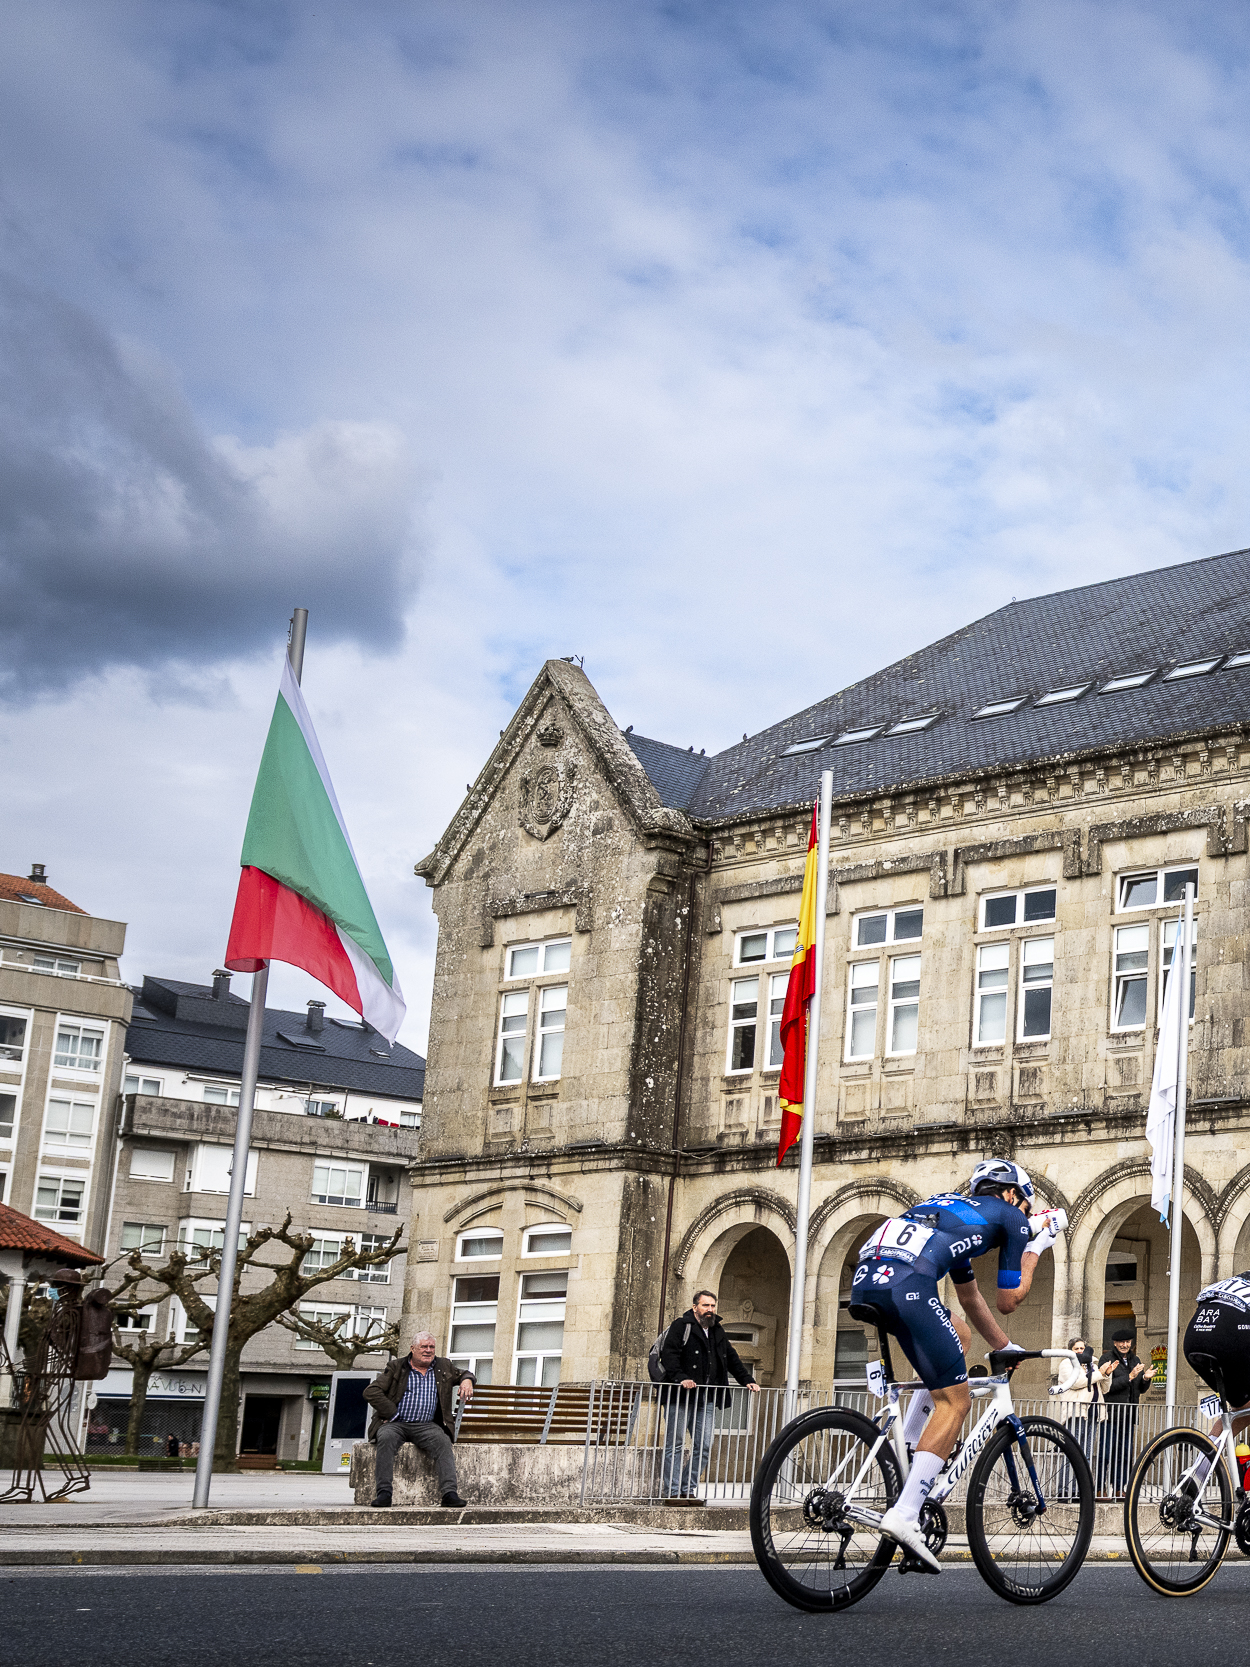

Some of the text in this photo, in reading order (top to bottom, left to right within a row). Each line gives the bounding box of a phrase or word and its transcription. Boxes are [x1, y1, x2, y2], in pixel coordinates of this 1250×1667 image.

[896, 1223, 917, 1246] 6
[949, 1237, 972, 1258] FDJ
[927, 1297, 964, 1354] Groupama
[870, 1370, 881, 1380] 6
[1026, 1424, 1066, 1444] MICHE
[762, 1494, 777, 1560] MICHE
[1003, 1577, 1044, 1597] MICHE
